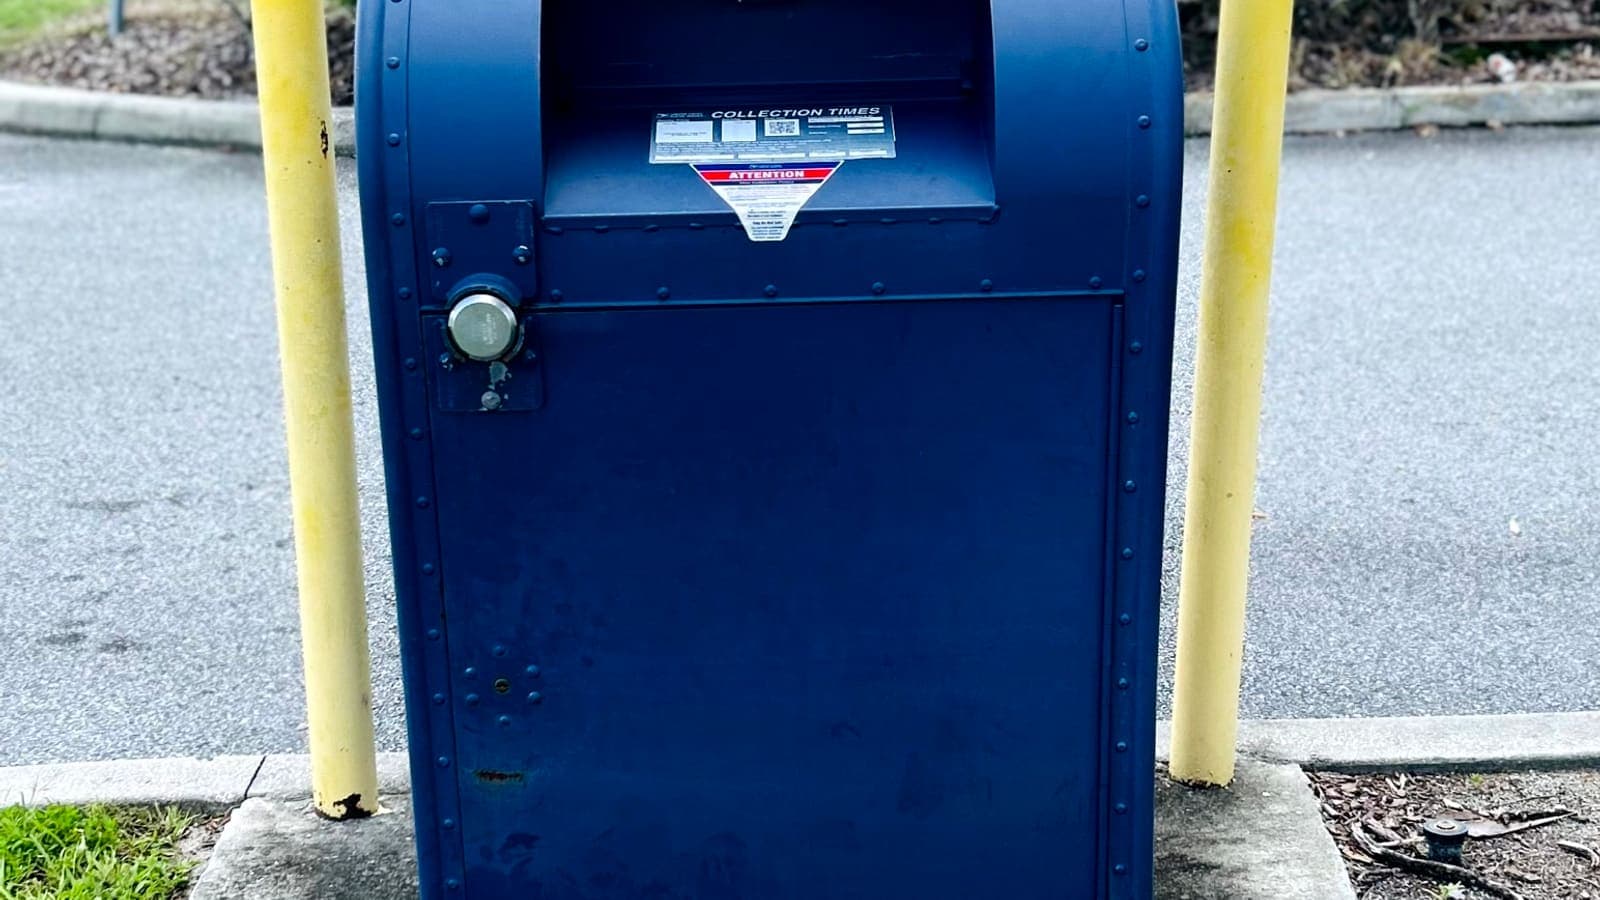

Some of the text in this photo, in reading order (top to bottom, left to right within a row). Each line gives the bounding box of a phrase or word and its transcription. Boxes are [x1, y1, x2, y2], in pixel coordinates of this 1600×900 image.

[711, 109, 823, 119] COLLECTION
[828, 107, 881, 116] TIMES
[729, 170, 804, 179] ATTENTION
